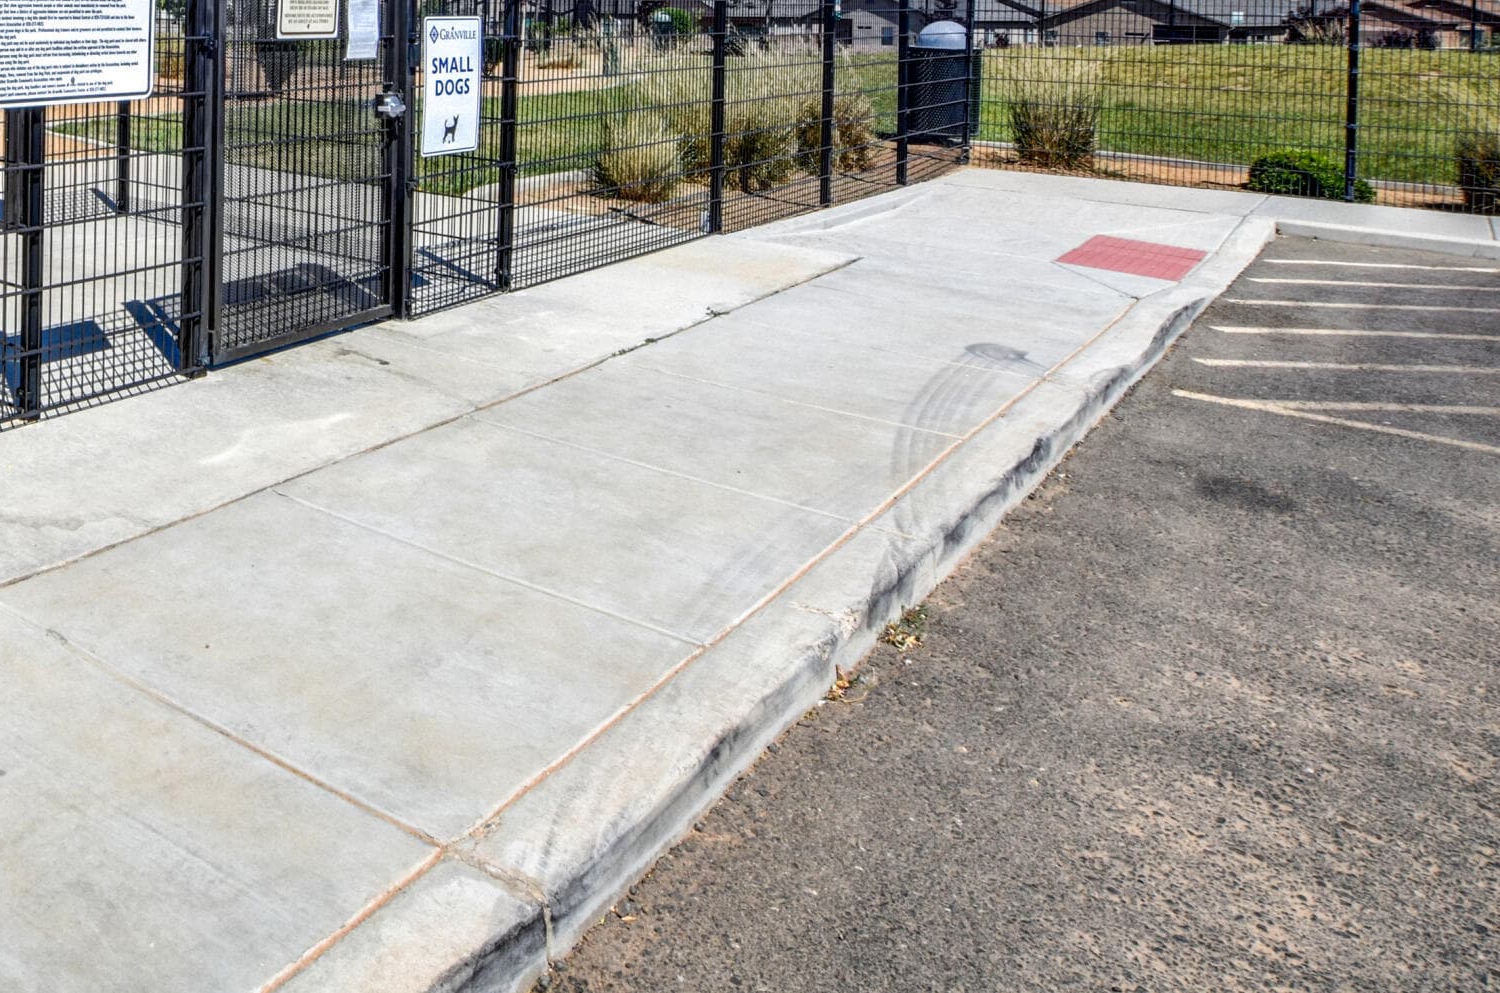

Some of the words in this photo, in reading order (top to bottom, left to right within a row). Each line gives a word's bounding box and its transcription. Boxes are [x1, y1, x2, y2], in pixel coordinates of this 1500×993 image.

[440, 28, 476, 41] GRANVILLE
[432, 56, 474, 74] SMALL
[435, 78, 470, 96] DOGS
